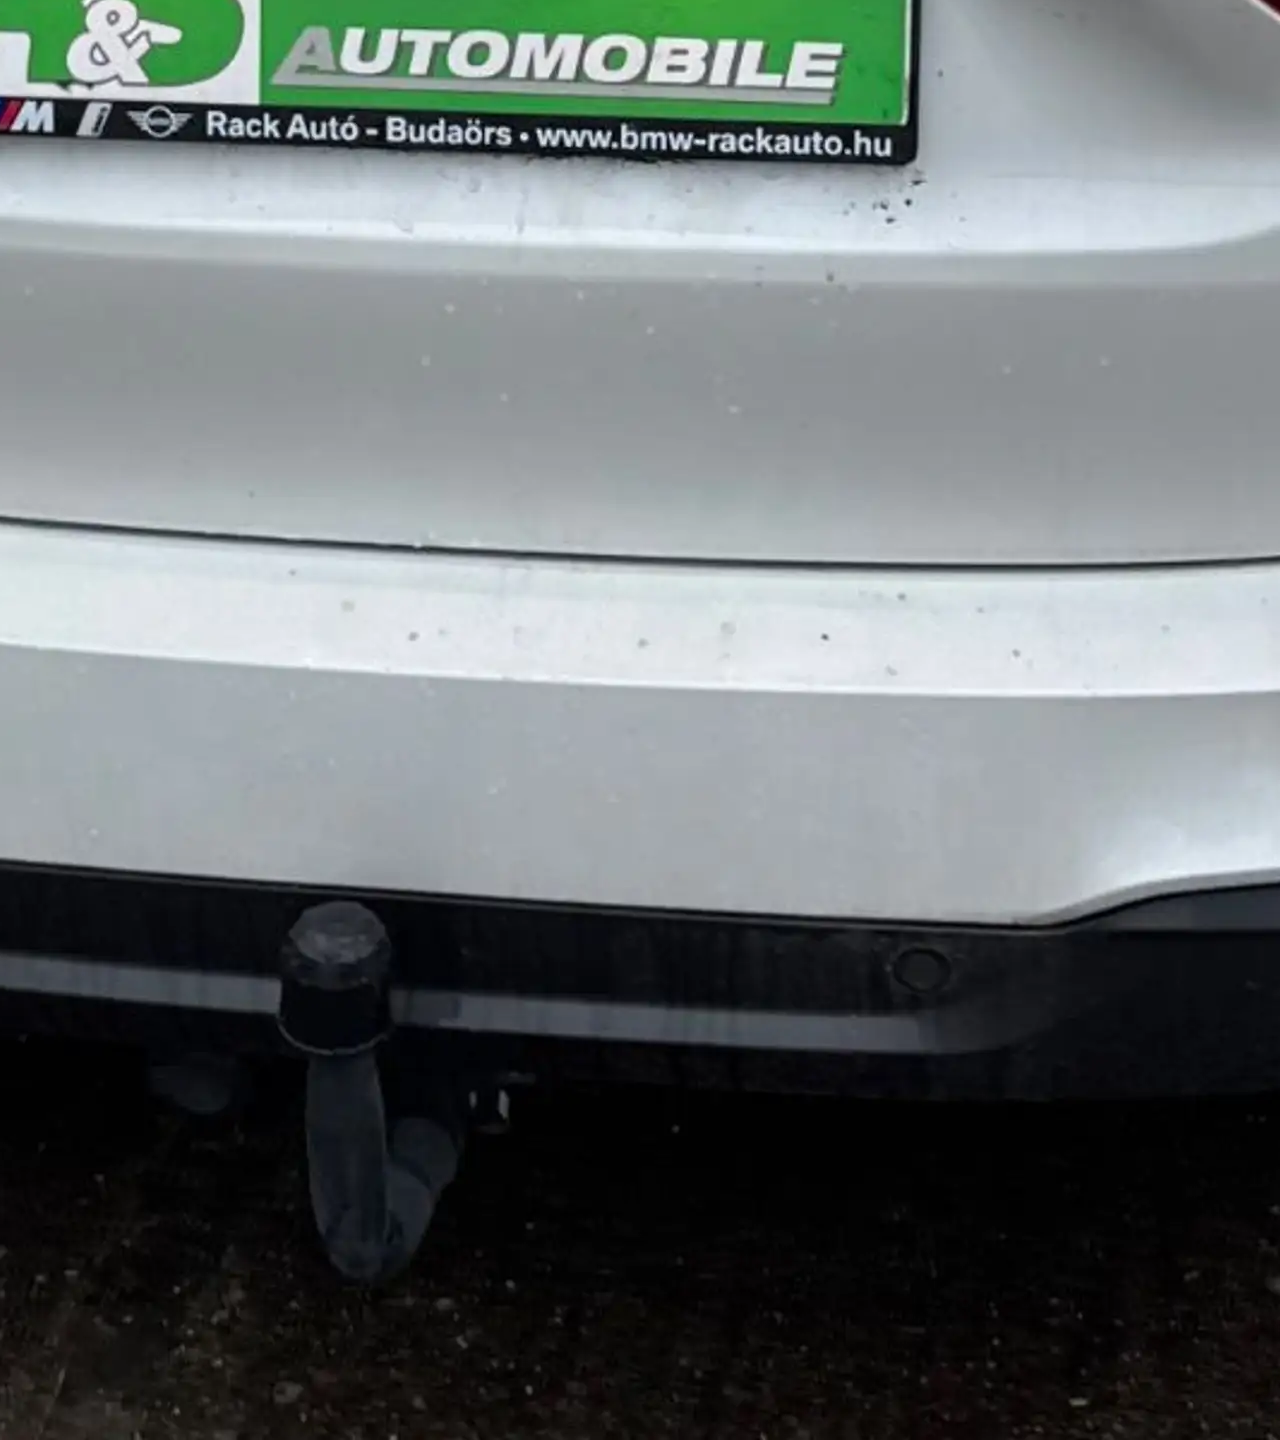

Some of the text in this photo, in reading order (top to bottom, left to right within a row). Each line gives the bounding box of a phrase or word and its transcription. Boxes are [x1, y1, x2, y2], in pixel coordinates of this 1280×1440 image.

[272, 25, 843, 90] AUTOMOBILE
[206, 110, 280, 138] Rack
[286, 113, 359, 141] Autó
[385, 116, 512, 146] Budaörs
[535, 123, 893, 157] www.bmw-rackauto.hu
